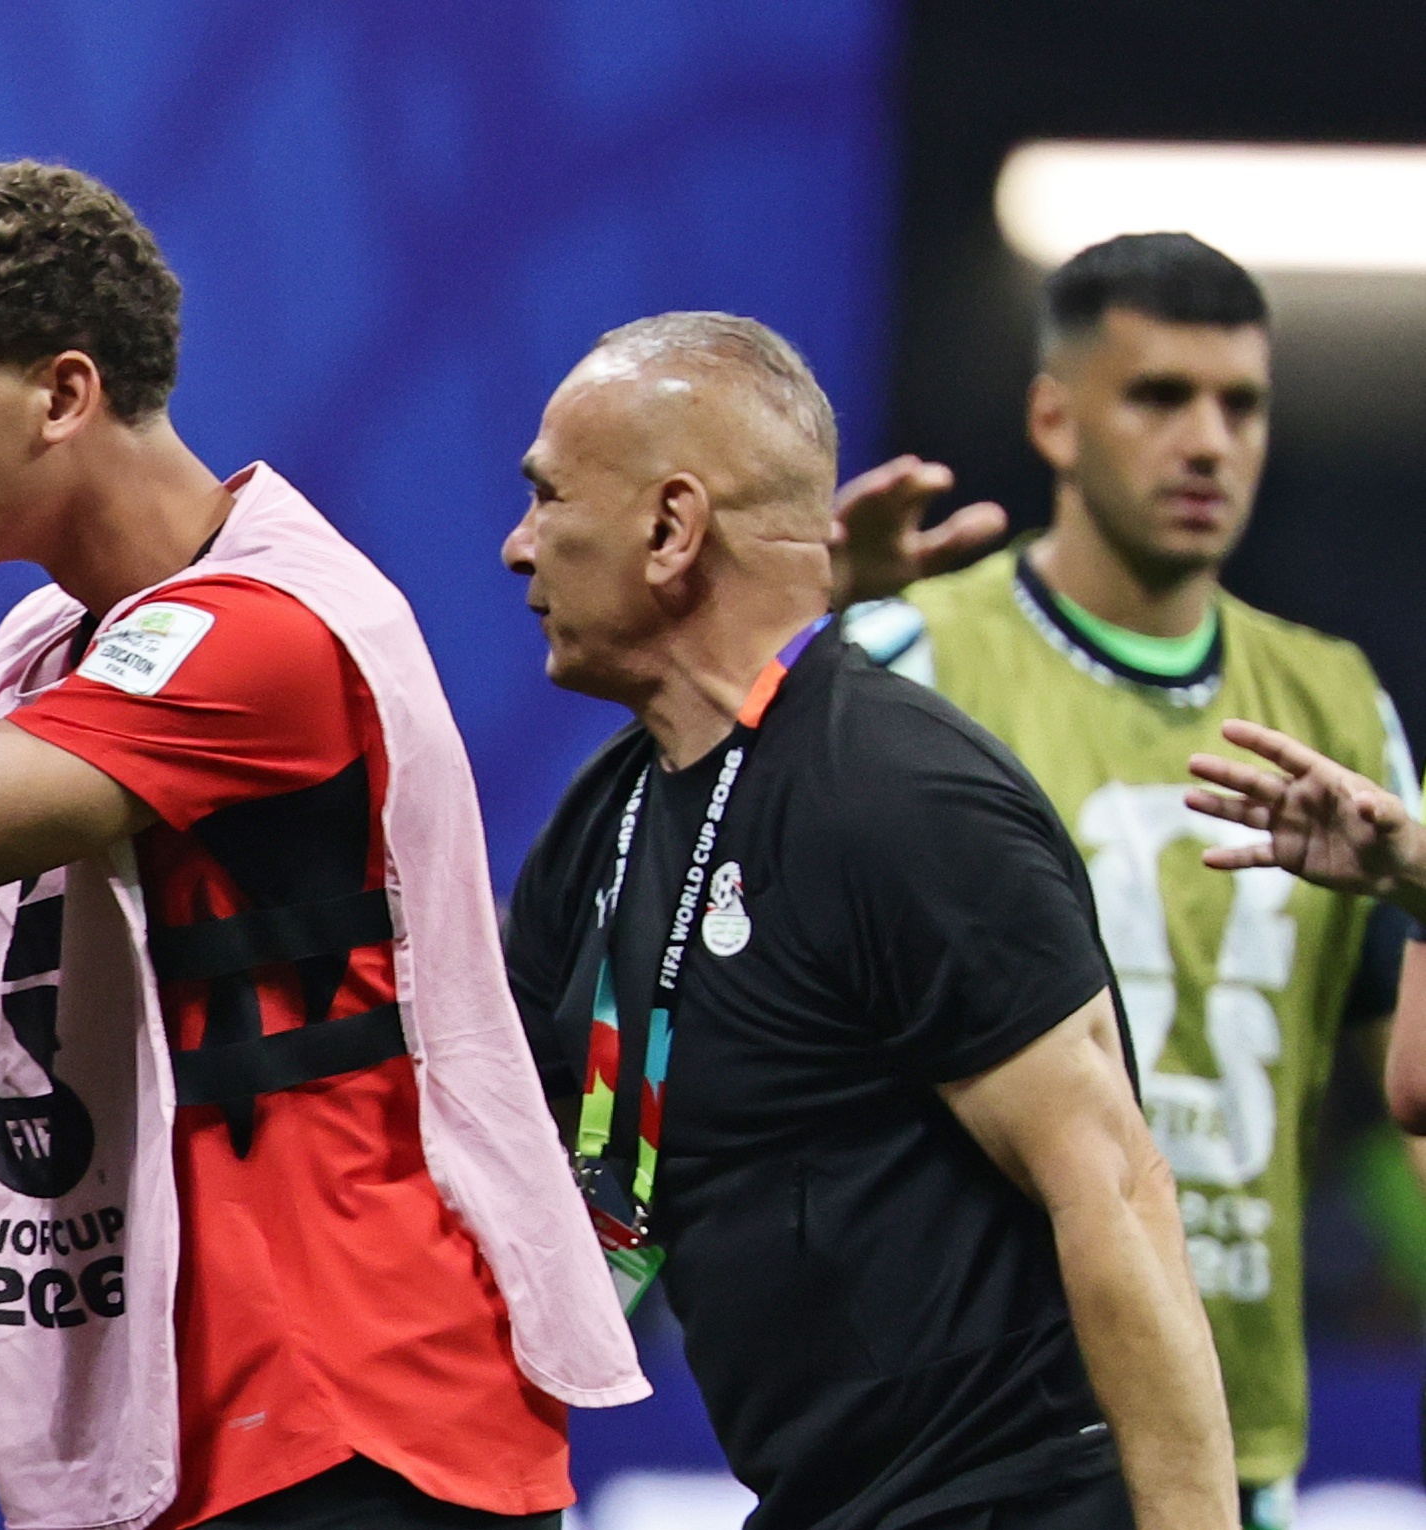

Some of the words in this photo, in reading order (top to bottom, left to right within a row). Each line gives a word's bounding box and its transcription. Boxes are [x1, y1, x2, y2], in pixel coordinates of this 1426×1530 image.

[99, 643, 157, 676] EDUCATION
[705, 749, 744, 822] 2026
[693, 822, 718, 866] CUP
[669, 866, 705, 942] WORLD
[659, 945, 685, 990] FIFA
[5, 1116, 51, 1161] FIF
